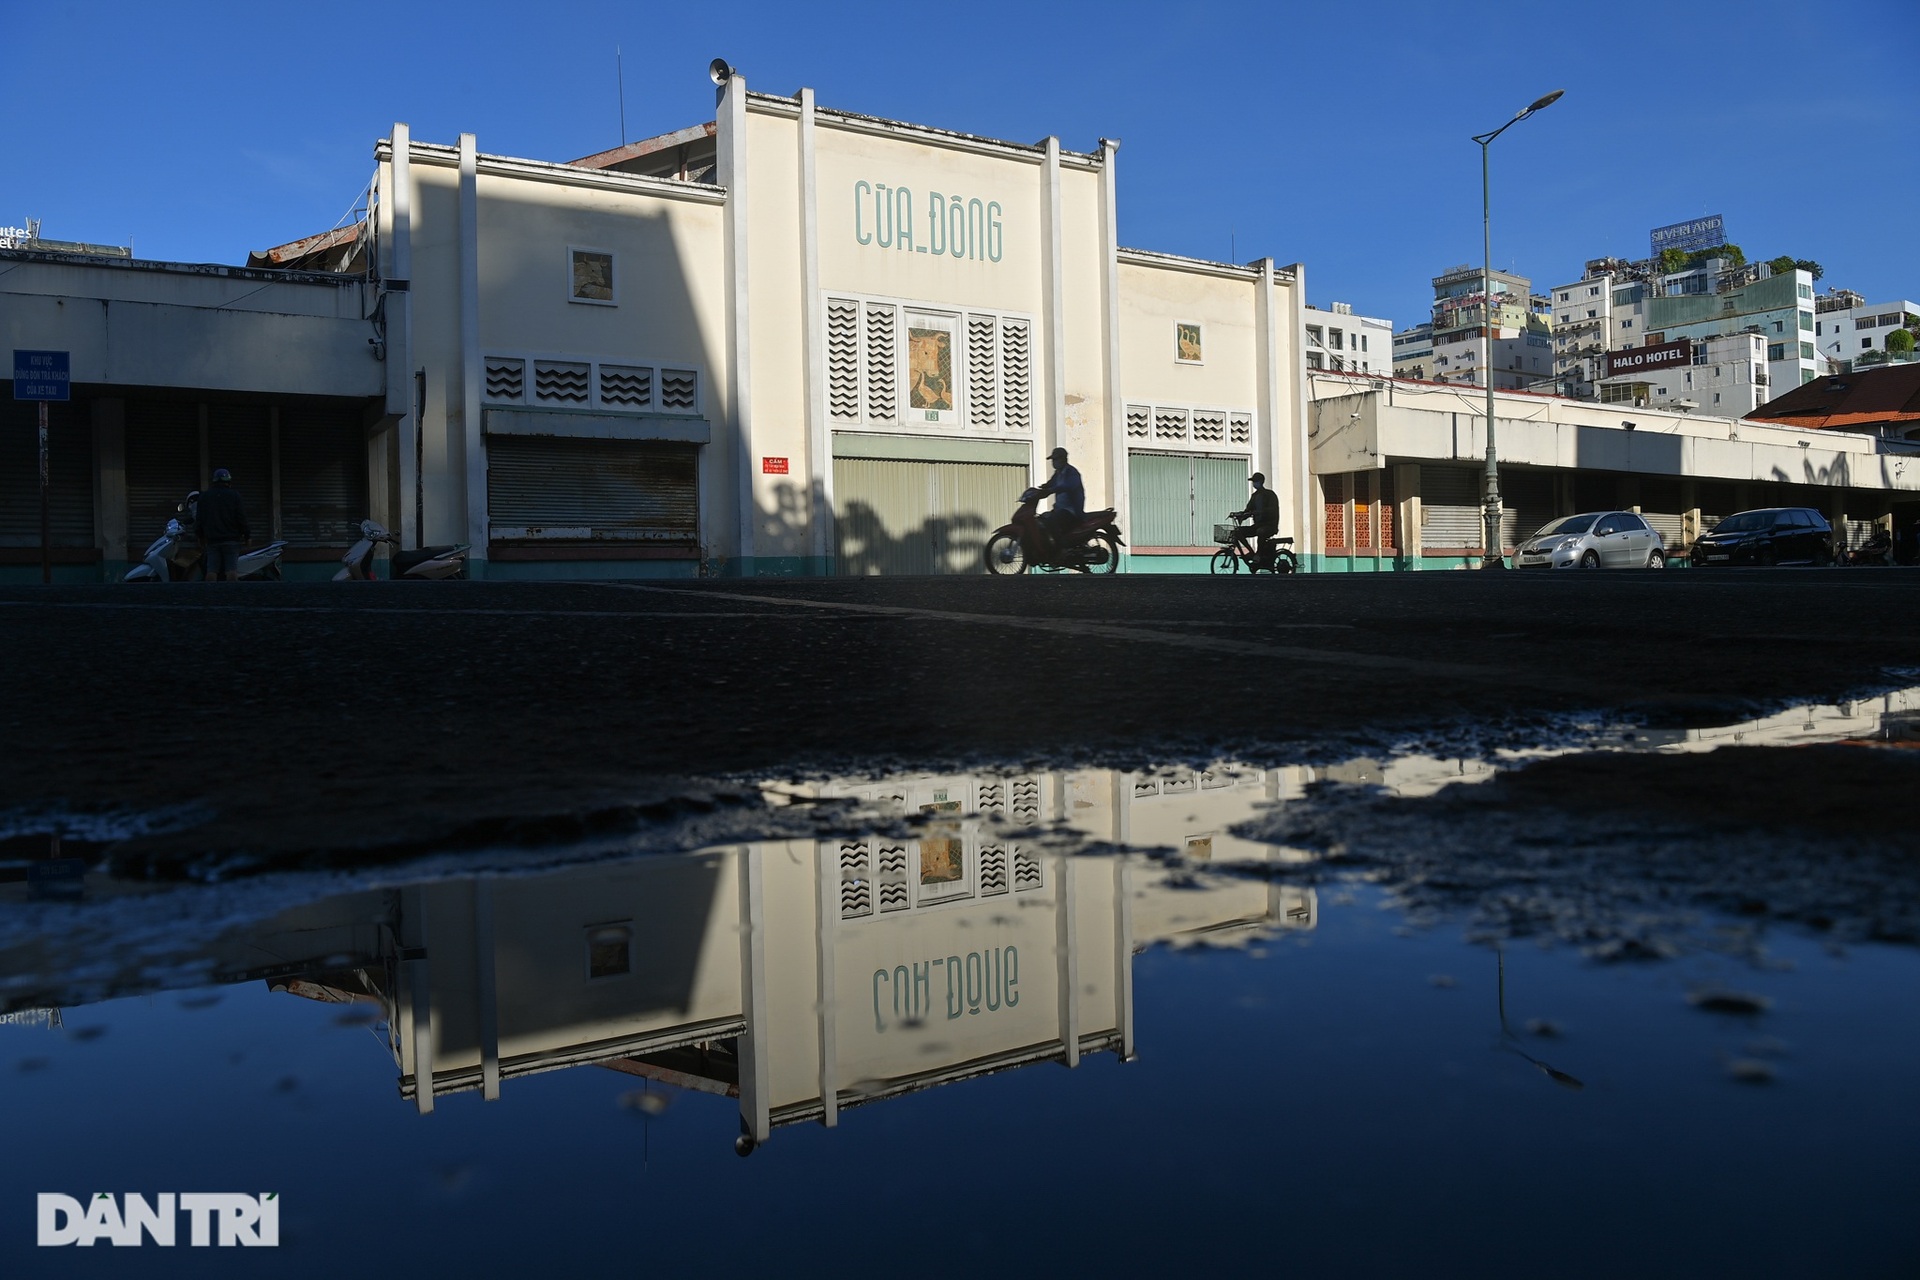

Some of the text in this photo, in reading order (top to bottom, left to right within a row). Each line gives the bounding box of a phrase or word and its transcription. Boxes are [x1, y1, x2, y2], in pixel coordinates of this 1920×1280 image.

[1651, 218, 1721, 242] SILVERLAND
[1613, 349, 1683, 368] HALO HOTEL
